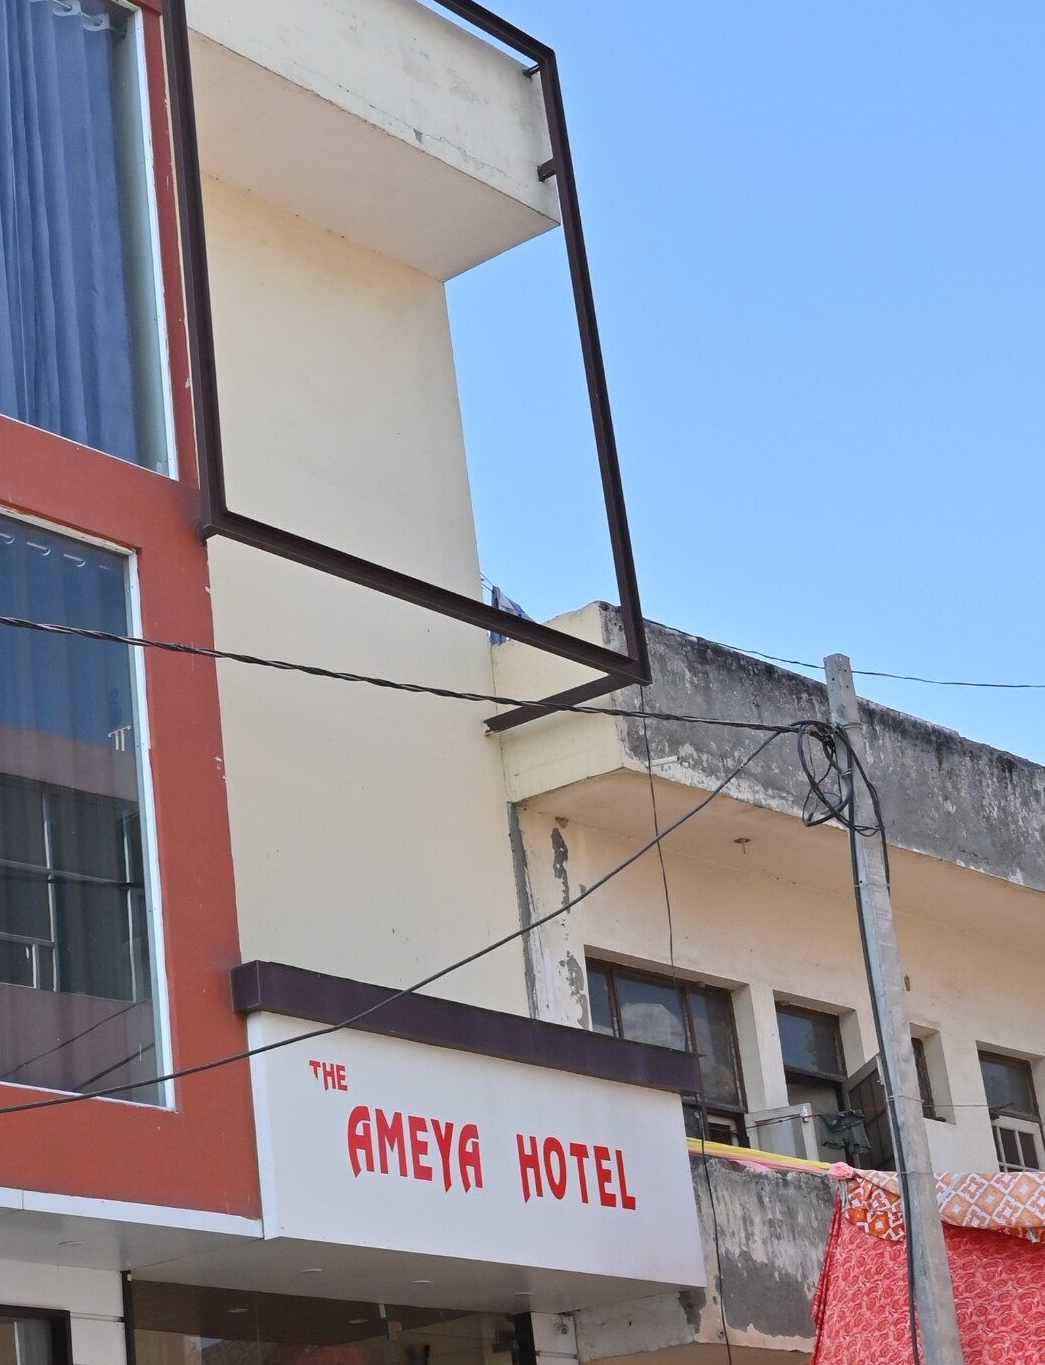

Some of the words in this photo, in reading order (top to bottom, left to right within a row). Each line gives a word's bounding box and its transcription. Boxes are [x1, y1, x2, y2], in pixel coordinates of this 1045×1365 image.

[308, 1060, 348, 1091] THE
[347, 1104, 483, 1193] AMEYA
[515, 1133, 636, 1210] HOTEL
